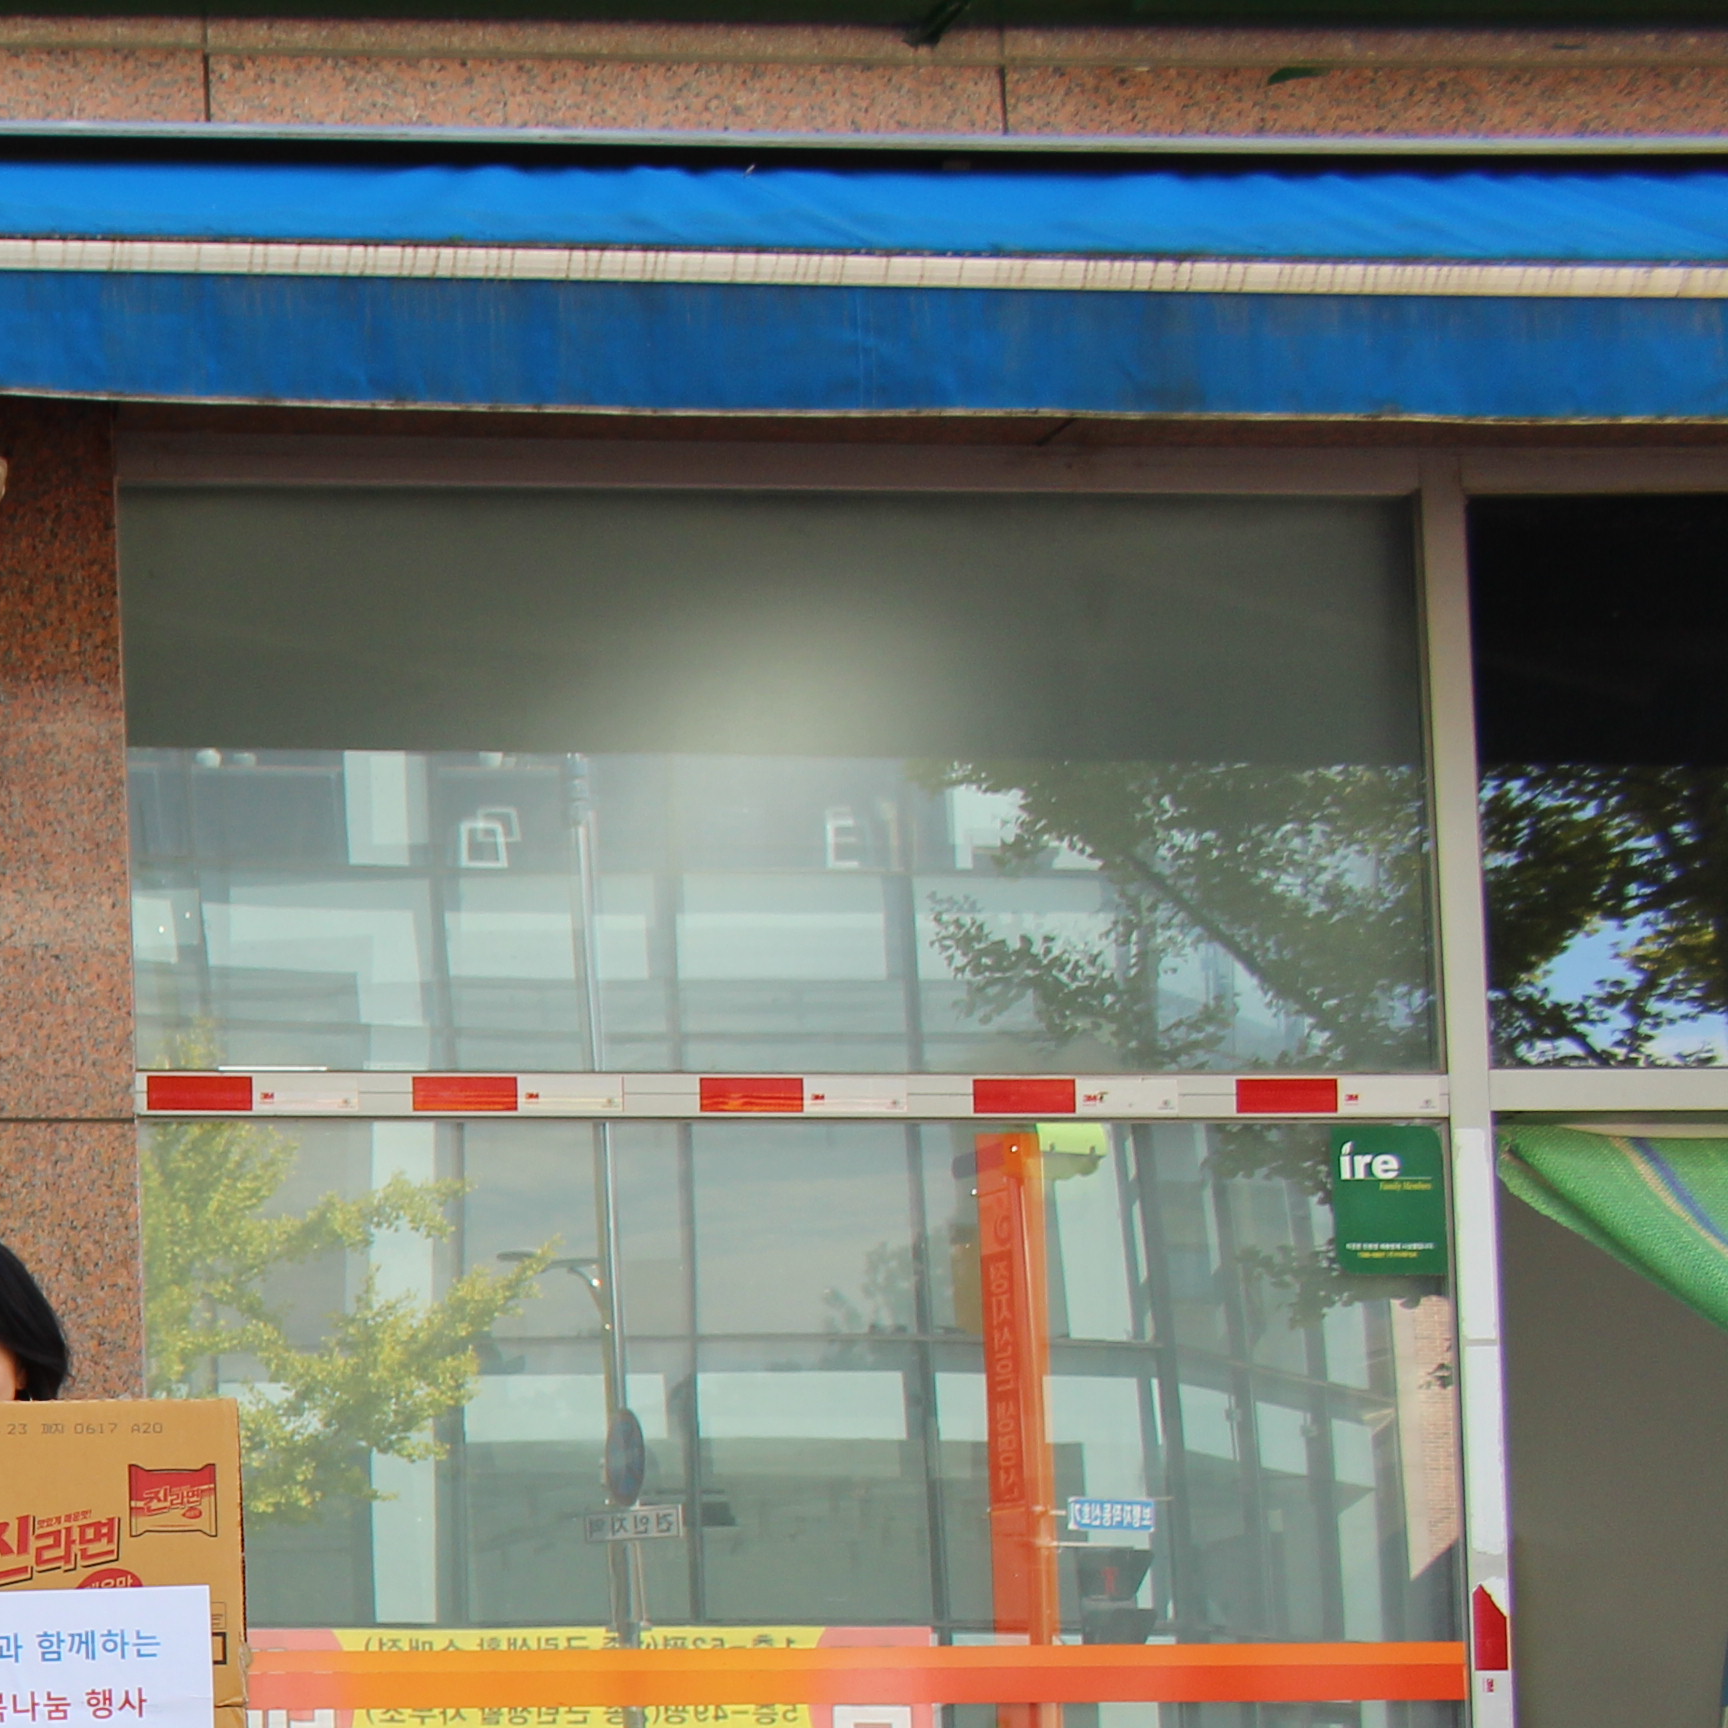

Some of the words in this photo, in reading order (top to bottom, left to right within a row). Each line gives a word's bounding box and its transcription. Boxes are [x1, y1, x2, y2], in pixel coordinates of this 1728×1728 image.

[74, 1422, 118, 1435] 0617
[131, 1422, 164, 1434] A20
[144, 1485, 203, 1514] 진라면
[35, 1629, 162, 1662] 함께하는
[85, 1688, 147, 1721] 행사
